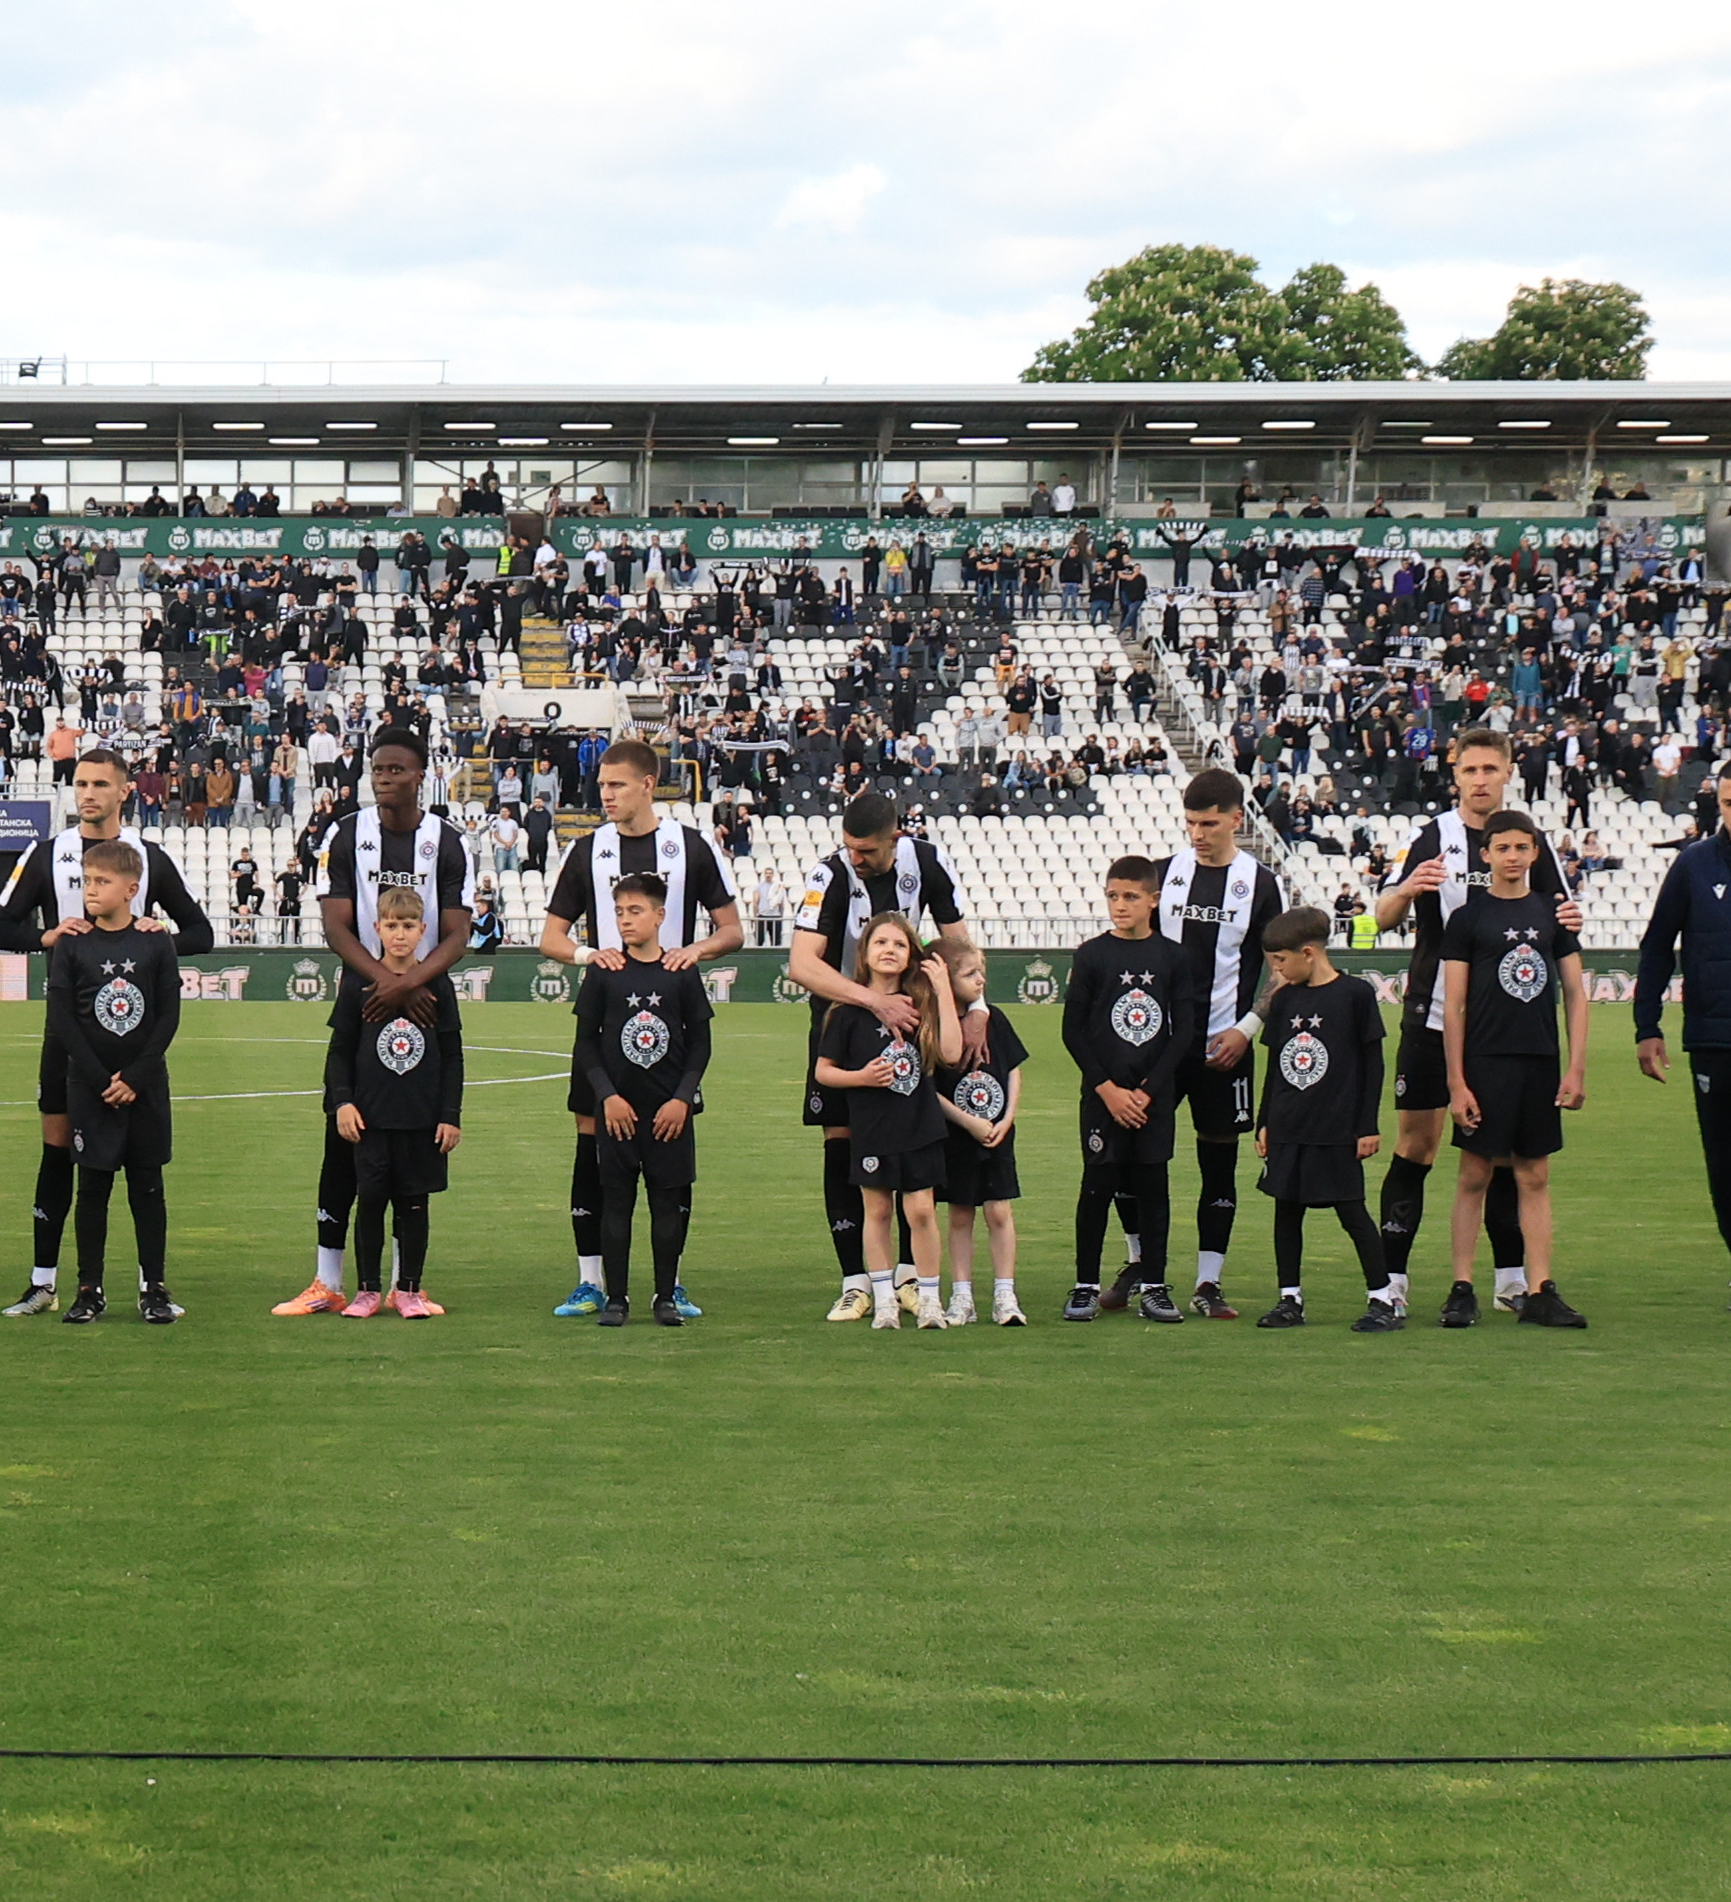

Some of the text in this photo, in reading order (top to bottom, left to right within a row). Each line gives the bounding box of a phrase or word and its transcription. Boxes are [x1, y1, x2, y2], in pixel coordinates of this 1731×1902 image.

[194, 528, 283, 549] MAXBET
[366, 869, 428, 887] MAXBET
[1171, 904, 1238, 923] MAXBET
[1232, 1077, 1249, 1110] 11
